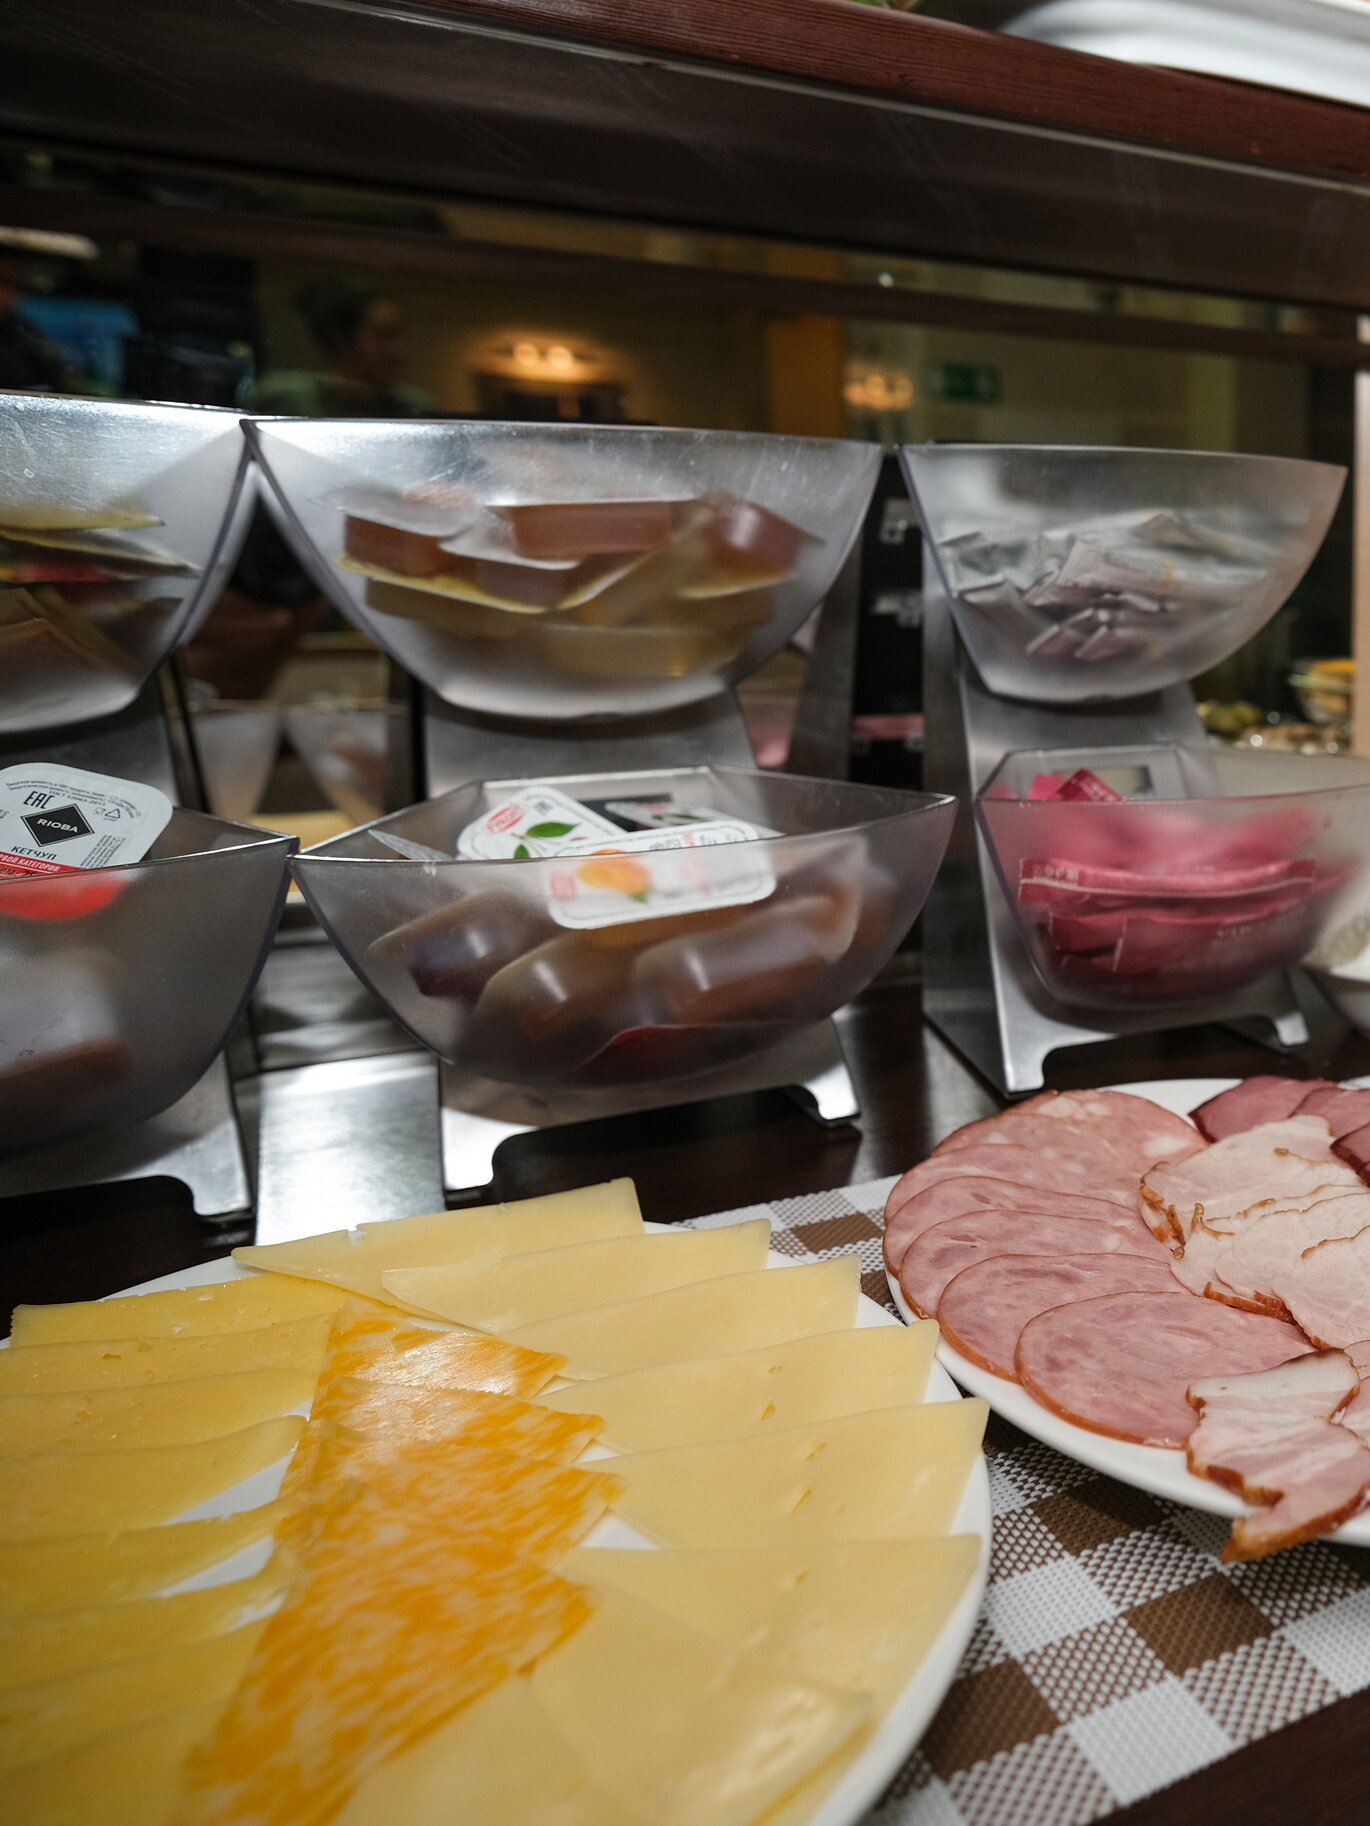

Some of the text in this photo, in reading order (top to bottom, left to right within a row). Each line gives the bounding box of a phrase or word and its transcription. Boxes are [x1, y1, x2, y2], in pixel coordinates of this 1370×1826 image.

[22, 790, 55, 810] EAC
[37, 818, 78, 833] RIOBA
[11, 846, 57, 860] КЕТЧУП
[18, 859, 61, 872] КАТЕГОРИИ
